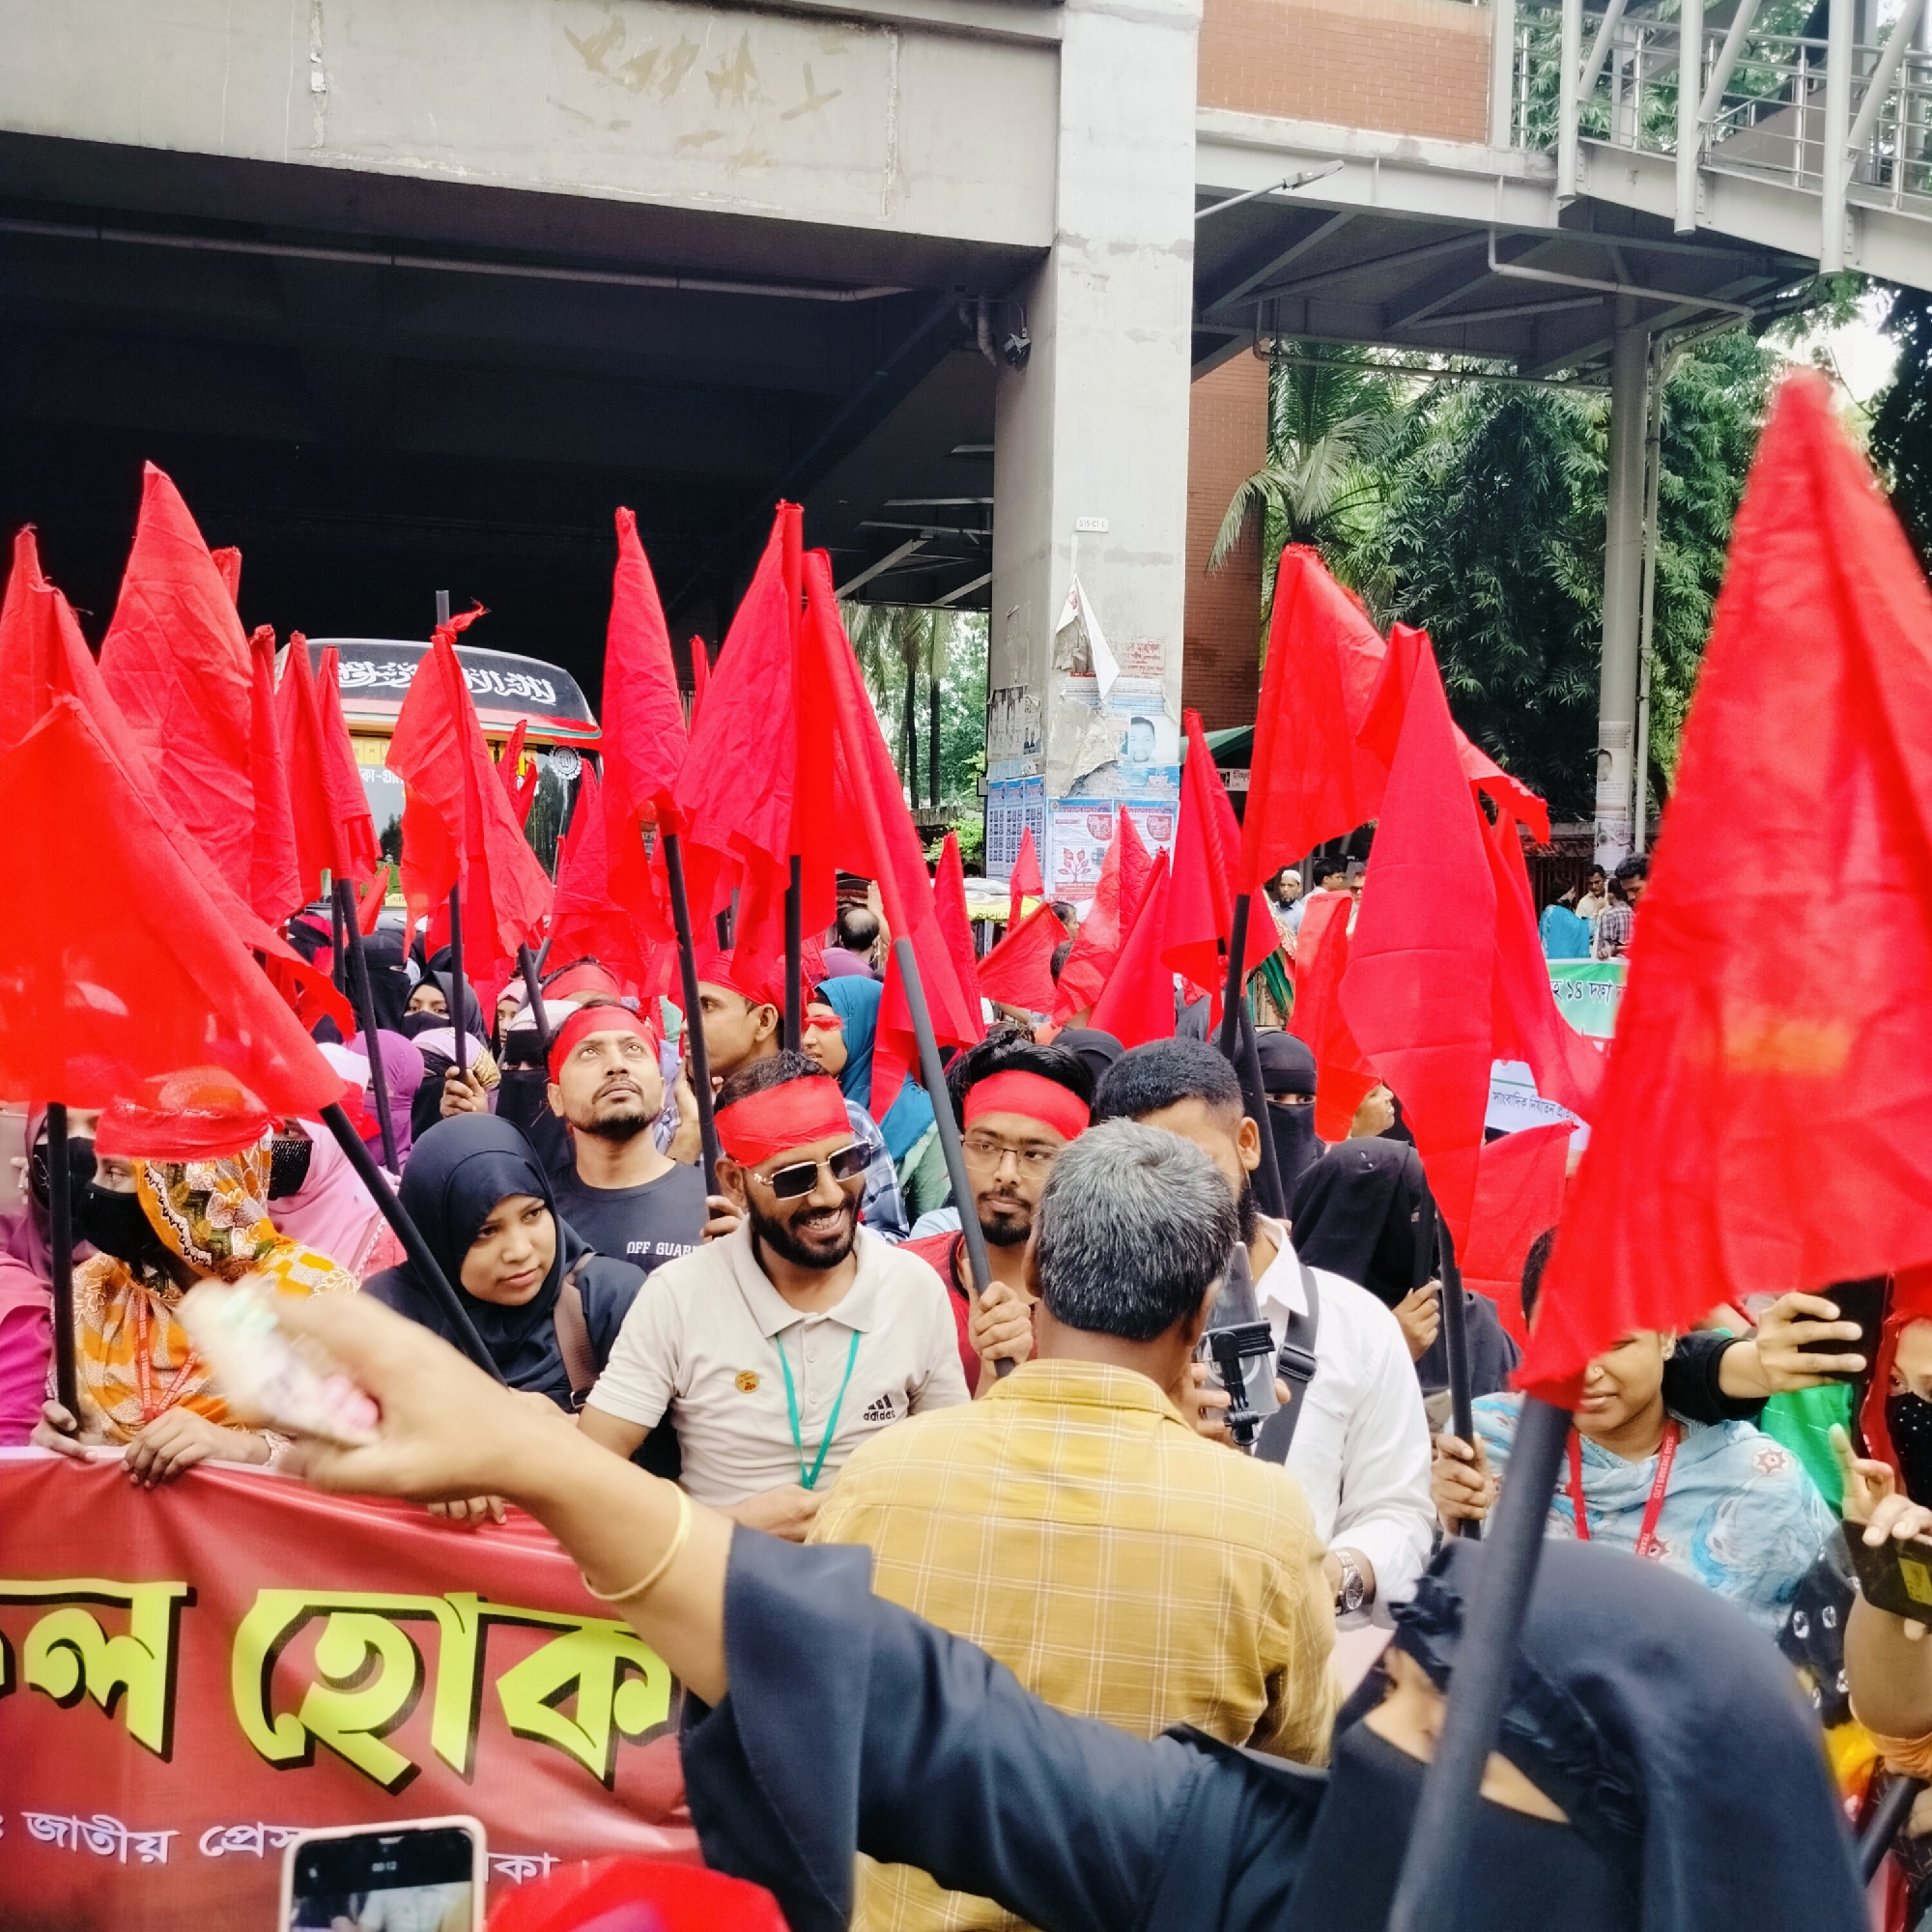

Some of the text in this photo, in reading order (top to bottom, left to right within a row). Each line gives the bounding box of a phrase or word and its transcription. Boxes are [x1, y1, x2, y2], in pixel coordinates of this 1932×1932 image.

[1566, 980, 1583, 1001] ১৪
[1587, 980, 1613, 1005] দফা
[1492, 1091, 1528, 1109] সাংবাদিক
[626, 1240, 694, 1257] OFF GUAR
[143, 1389, 152, 1408] TEXAS
[863, 1409, 895, 1422] adidas
[1664, 1435, 1675, 1455] TEXAS
[1656, 1455, 1669, 1484] DRESSES
[1637, 1532, 1651, 1555] TEXAS
[232, 1589, 673, 1793] হোক
[20, 1812, 181, 1864] জাতীয়
[484, 1852, 561, 1885] কা
